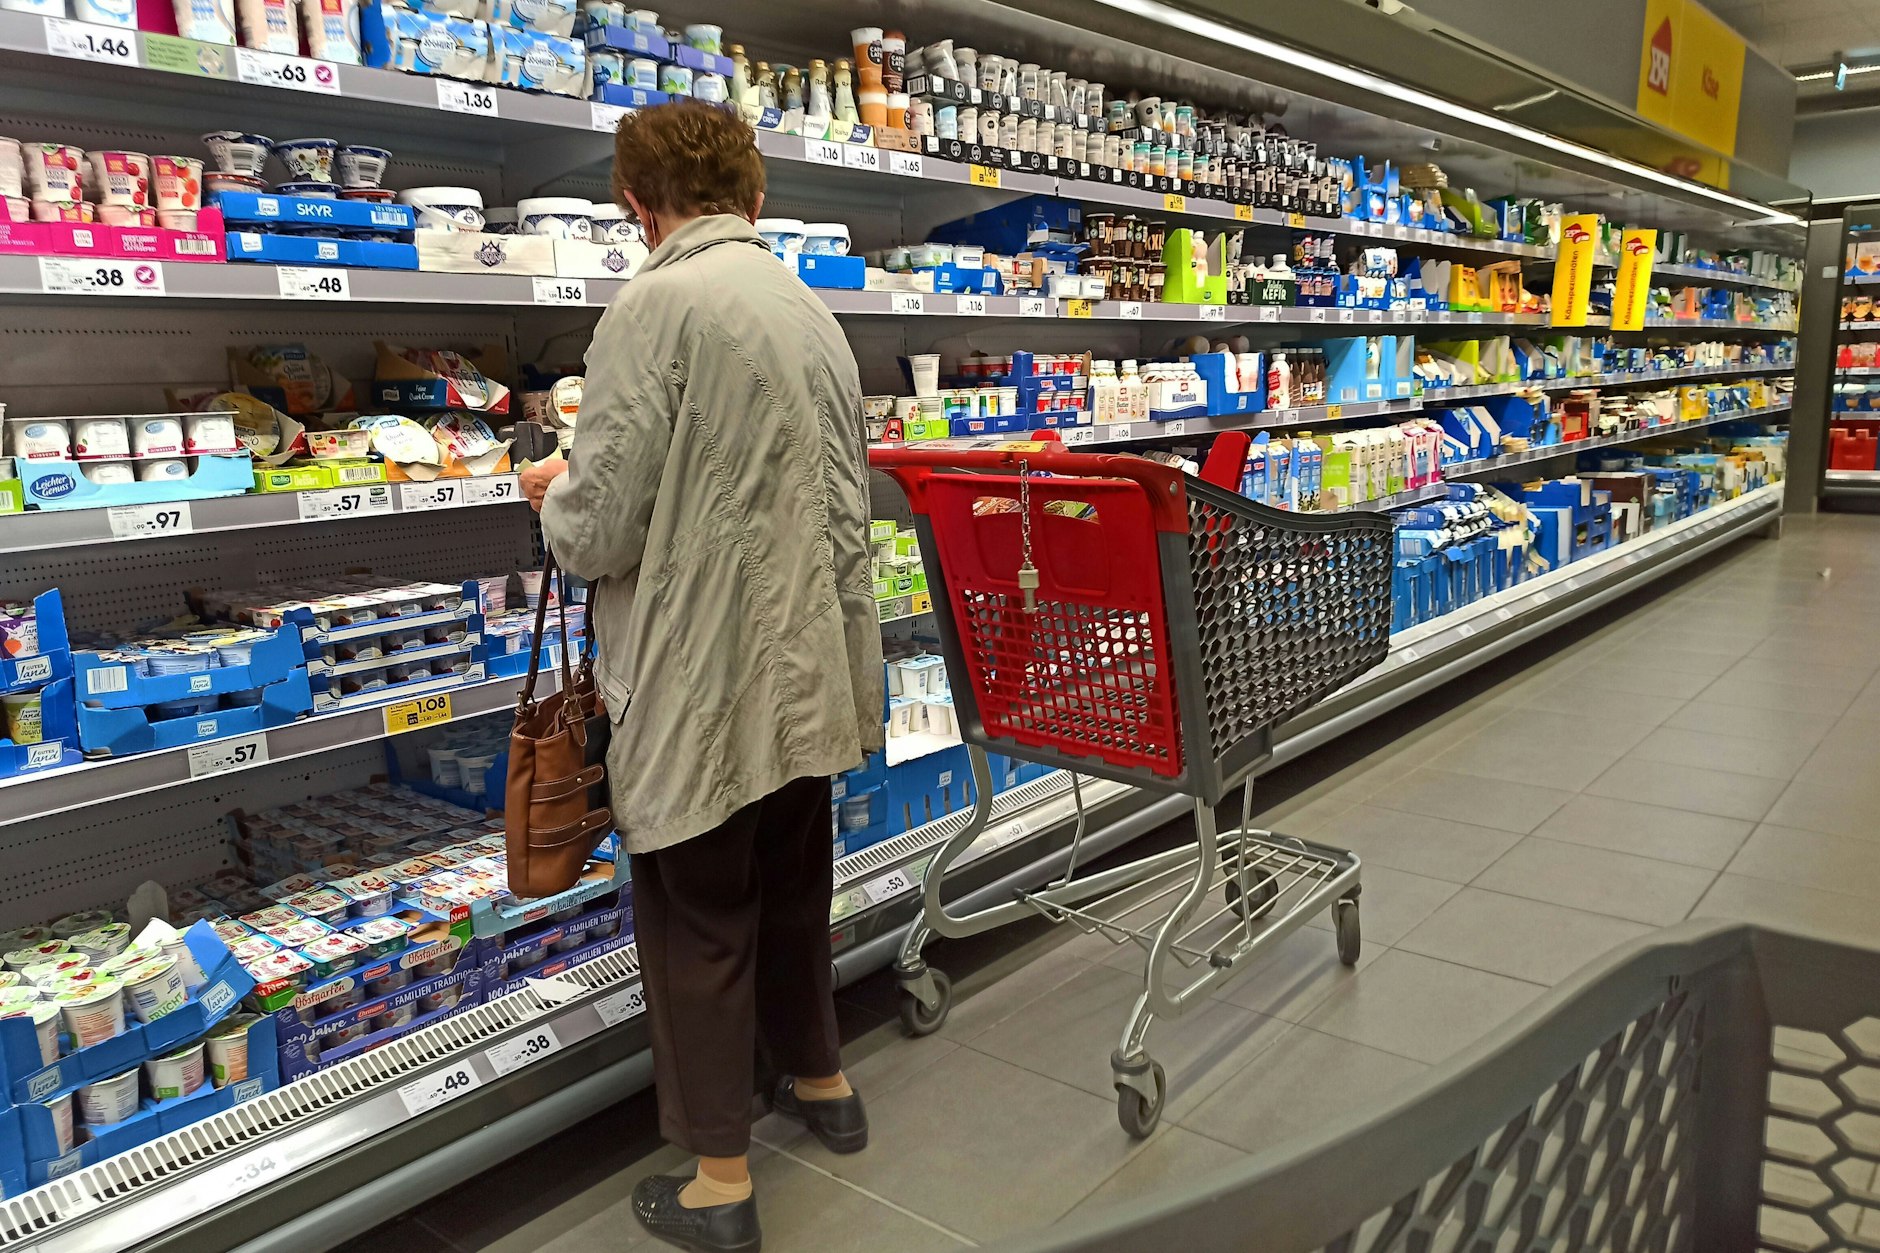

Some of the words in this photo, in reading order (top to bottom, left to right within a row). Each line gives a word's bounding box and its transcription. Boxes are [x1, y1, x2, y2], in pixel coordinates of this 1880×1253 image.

[85, 33, 129, 57] 1.46
[463, 91, 492, 109] 1.36
[822, 146, 838, 160] 1.16
[860, 152, 876, 165] 1.16
[903, 160, 920, 173] 1.65
[296, 203, 334, 218] SKYR
[556, 286, 582, 300] 1.56
[1262, 288, 1287, 300] KEFIR
[906, 299, 920, 310] 1.16
[969, 300, 983, 311] 1.16
[969, 421, 985, 431] TUFFI
[35, 475, 67, 491] Leichter
[42, 484, 69, 497] Genuss
[17, 664, 50, 682] Land
[416, 696, 446, 714] 1.08
[29, 749, 60, 766] Land
[450, 911, 469, 924] Neu
[569, 919, 599, 934] FAMILIEN
[408, 942, 453, 964] Obstgarten
[500, 944, 531, 964] Jahre
[572, 949, 601, 965] FAMILIEN
[603, 934, 635, 952] TRADITION
[364, 965, 390, 980] Ehrmann
[543, 963, 567, 976] Ehrmann
[267, 979, 289, 993] Neu
[395, 987, 432, 1006] FAMILIEN
[433, 968, 474, 990] TRADITION
[487, 987, 504, 1002] 100
[504, 977, 527, 996] Jahr
[207, 987, 234, 1010] Land
[294, 984, 345, 1009] Obstgarten
[148, 992, 184, 1021] FRUCHT
[358, 1003, 386, 1020] Ehrmann
[309, 1019, 347, 1042] Jahre
